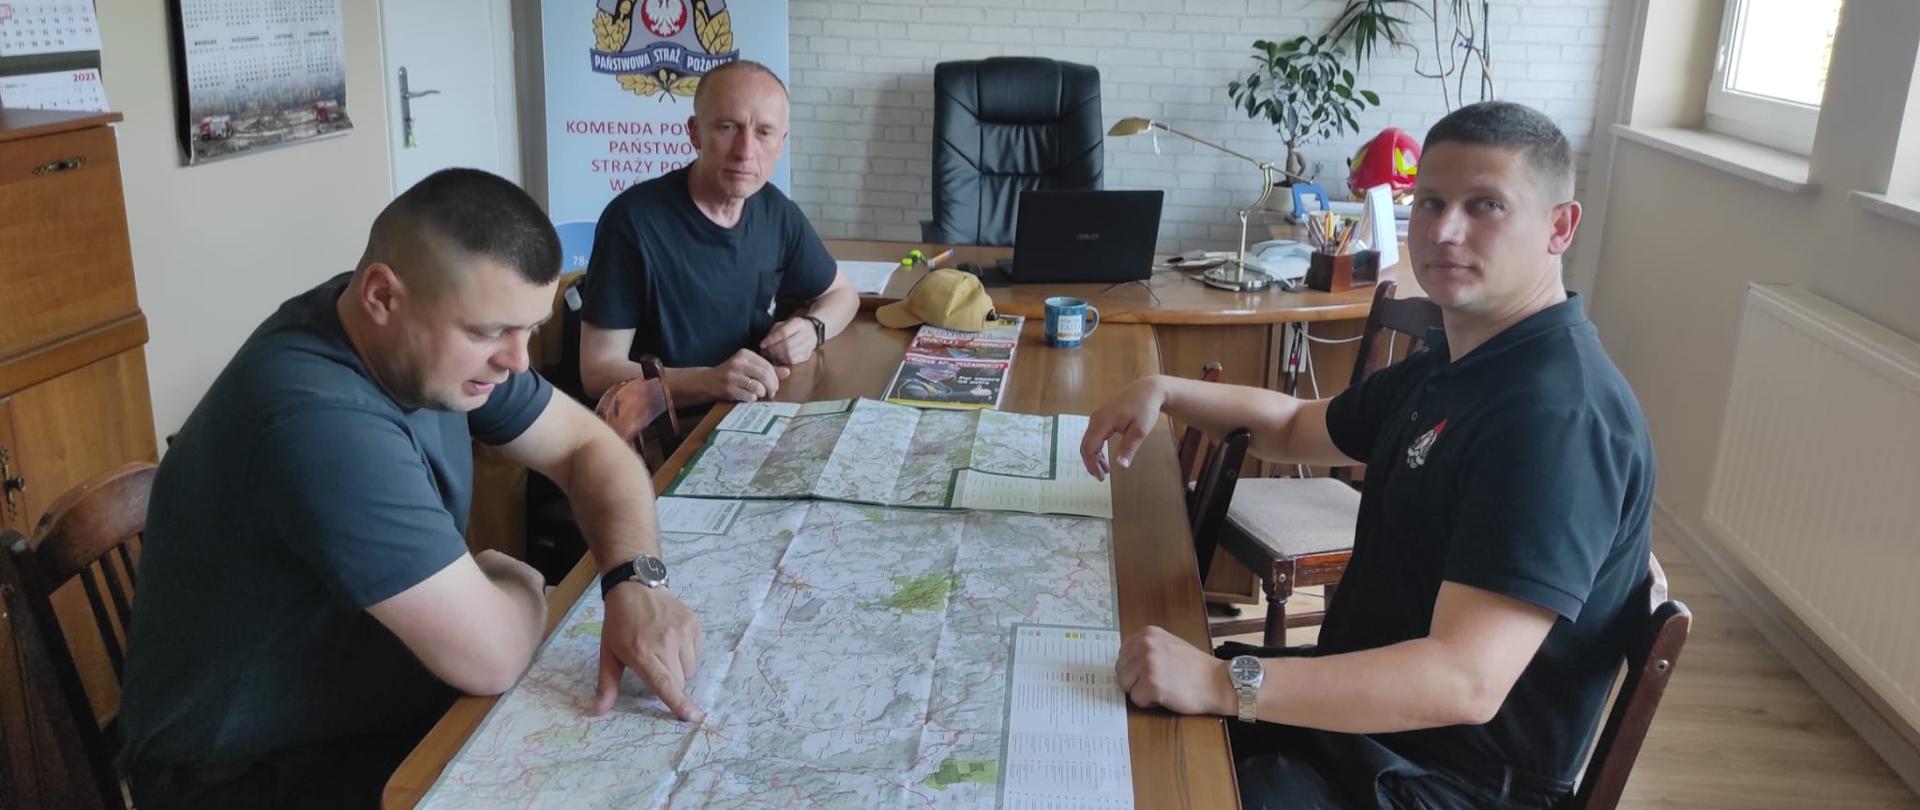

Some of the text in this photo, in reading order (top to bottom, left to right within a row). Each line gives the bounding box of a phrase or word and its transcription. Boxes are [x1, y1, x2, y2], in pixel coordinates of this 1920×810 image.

[594, 47, 733, 73] PAŃSTWOWA STRAŻ POŻAR
[73, 73, 96, 82] 2023
[566, 120, 653, 135] KOMENDA
[591, 157, 690, 173] STRAŻY PO
[609, 179, 625, 191] W
